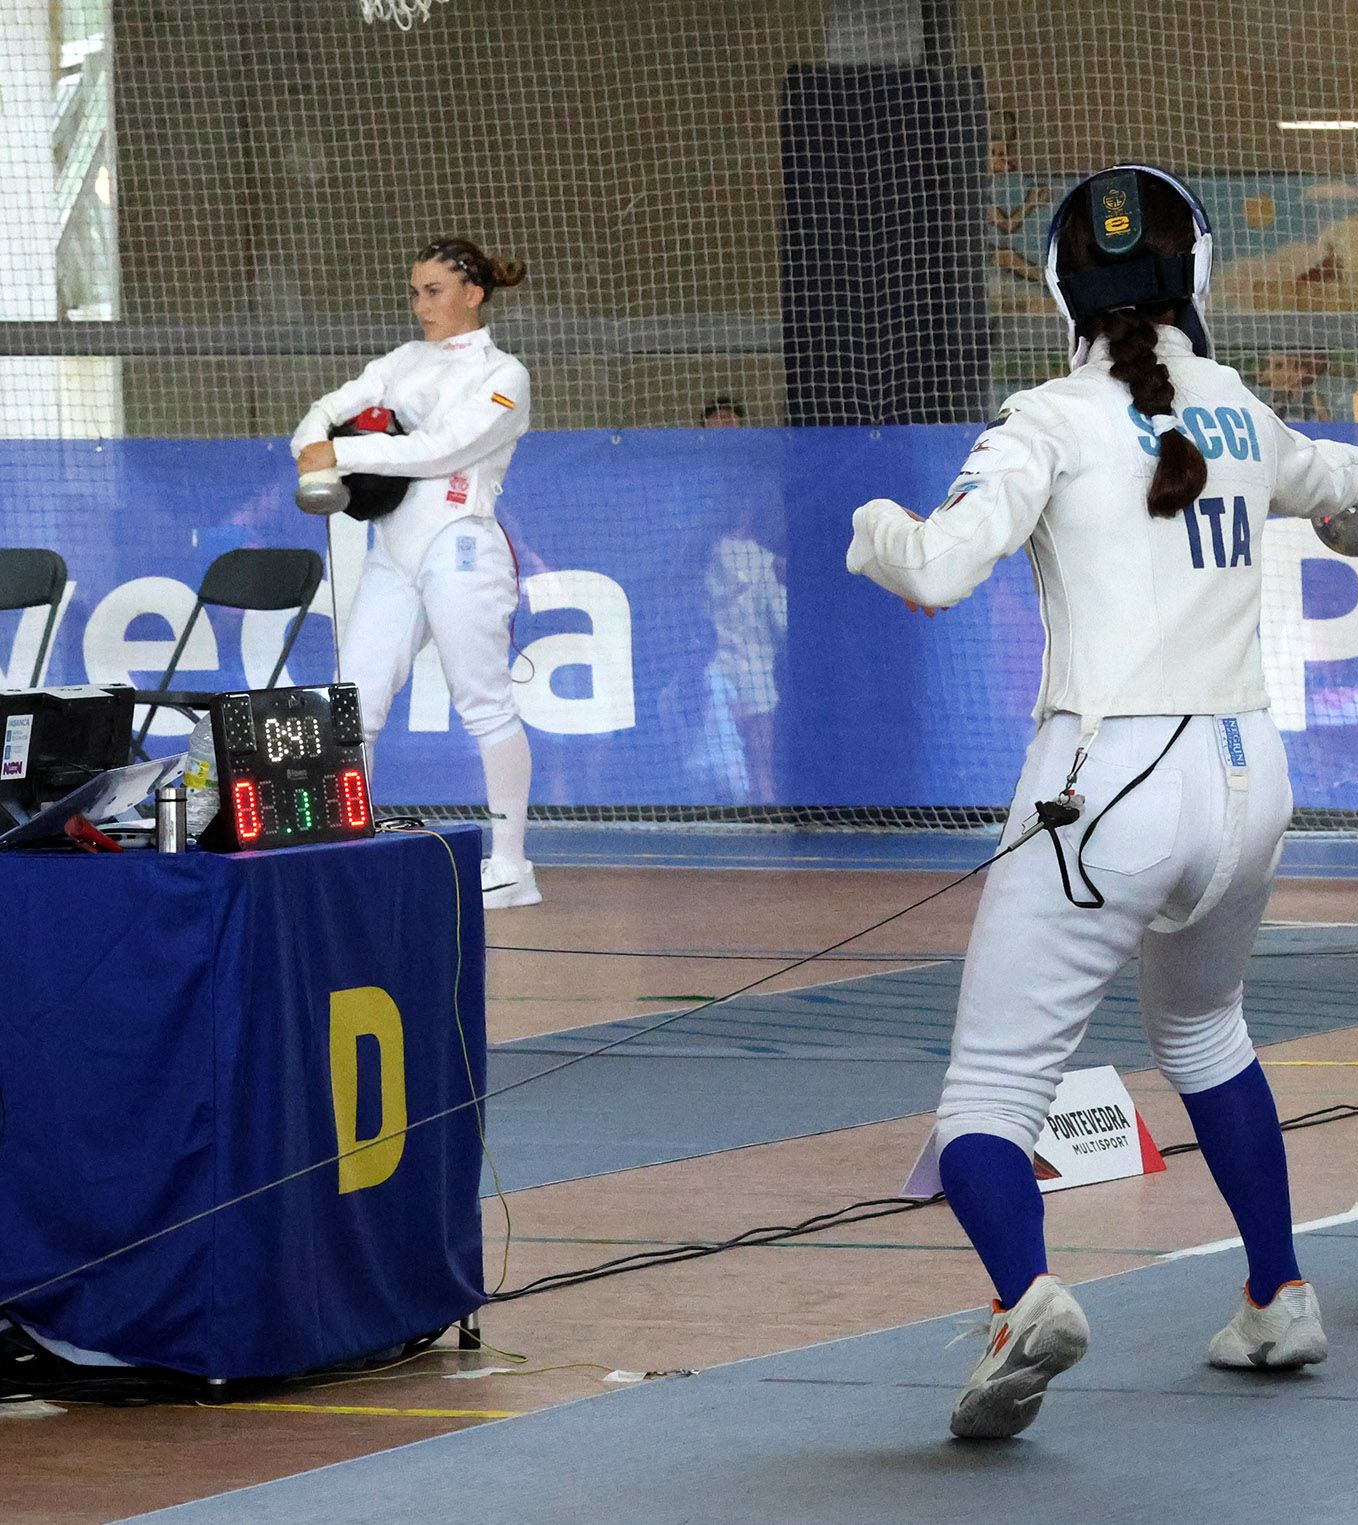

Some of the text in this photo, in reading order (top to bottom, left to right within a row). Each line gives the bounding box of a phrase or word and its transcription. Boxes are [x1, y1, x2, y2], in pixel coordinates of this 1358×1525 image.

[1127, 403, 1262, 462] SCCI
[1183, 496, 1252, 569] ITA
[329, 986, 408, 1194] D
[1046, 1104, 1131, 1140] PONTEVEDRA
[1072, 1135, 1129, 1155] MULTISPORT
